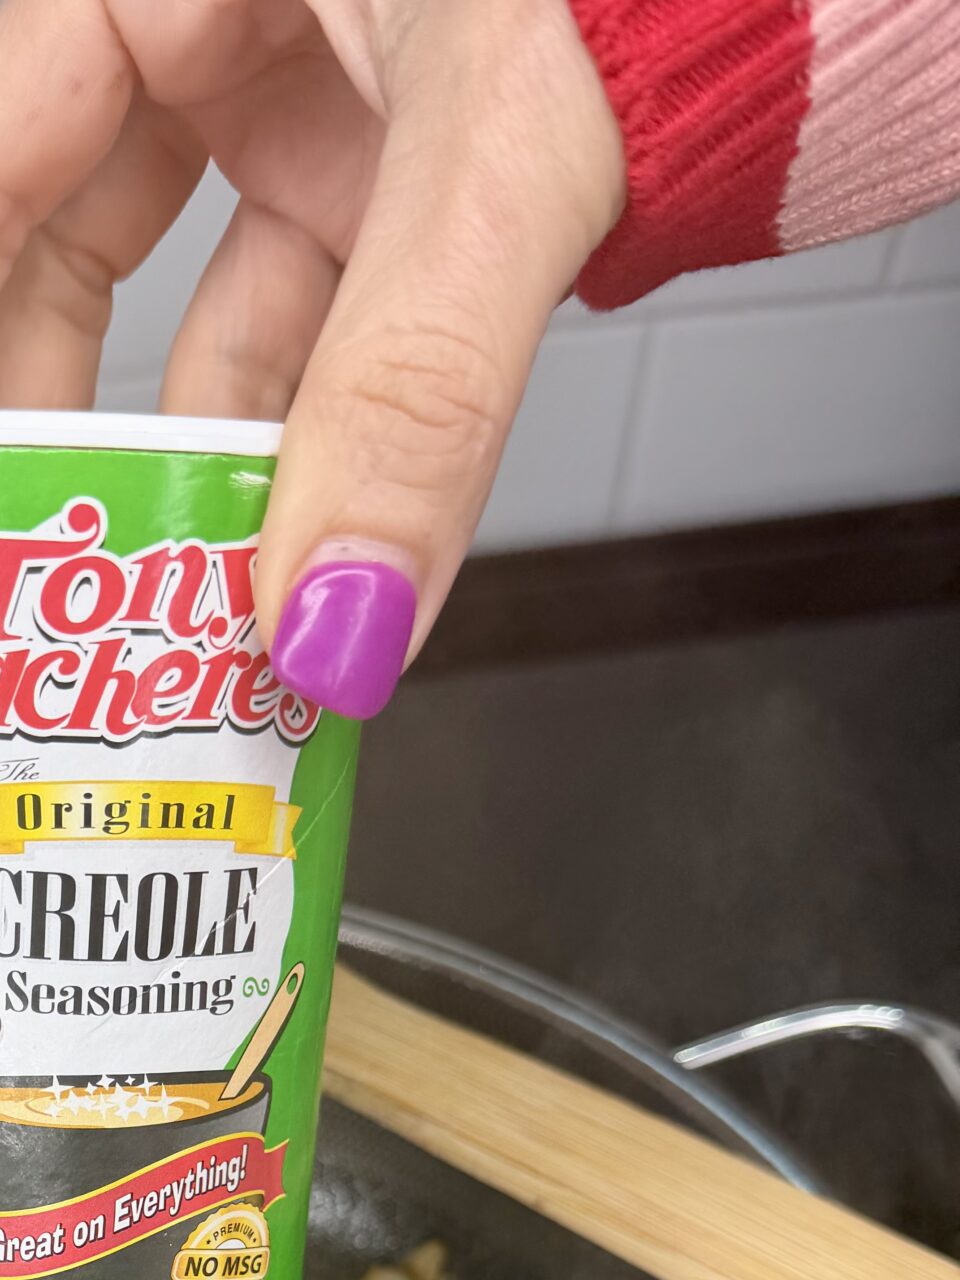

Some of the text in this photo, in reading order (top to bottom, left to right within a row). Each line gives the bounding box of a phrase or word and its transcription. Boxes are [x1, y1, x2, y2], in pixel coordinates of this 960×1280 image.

[16, 792, 235, 835] Original
[4, 969, 237, 1016] Seasoning
[72, 1213, 107, 1247] on
[114, 1144, 249, 1234] Everything!
[212, 1222, 254, 1240] PREMIUM
[184, 1254, 263, 1277] NO MSG
